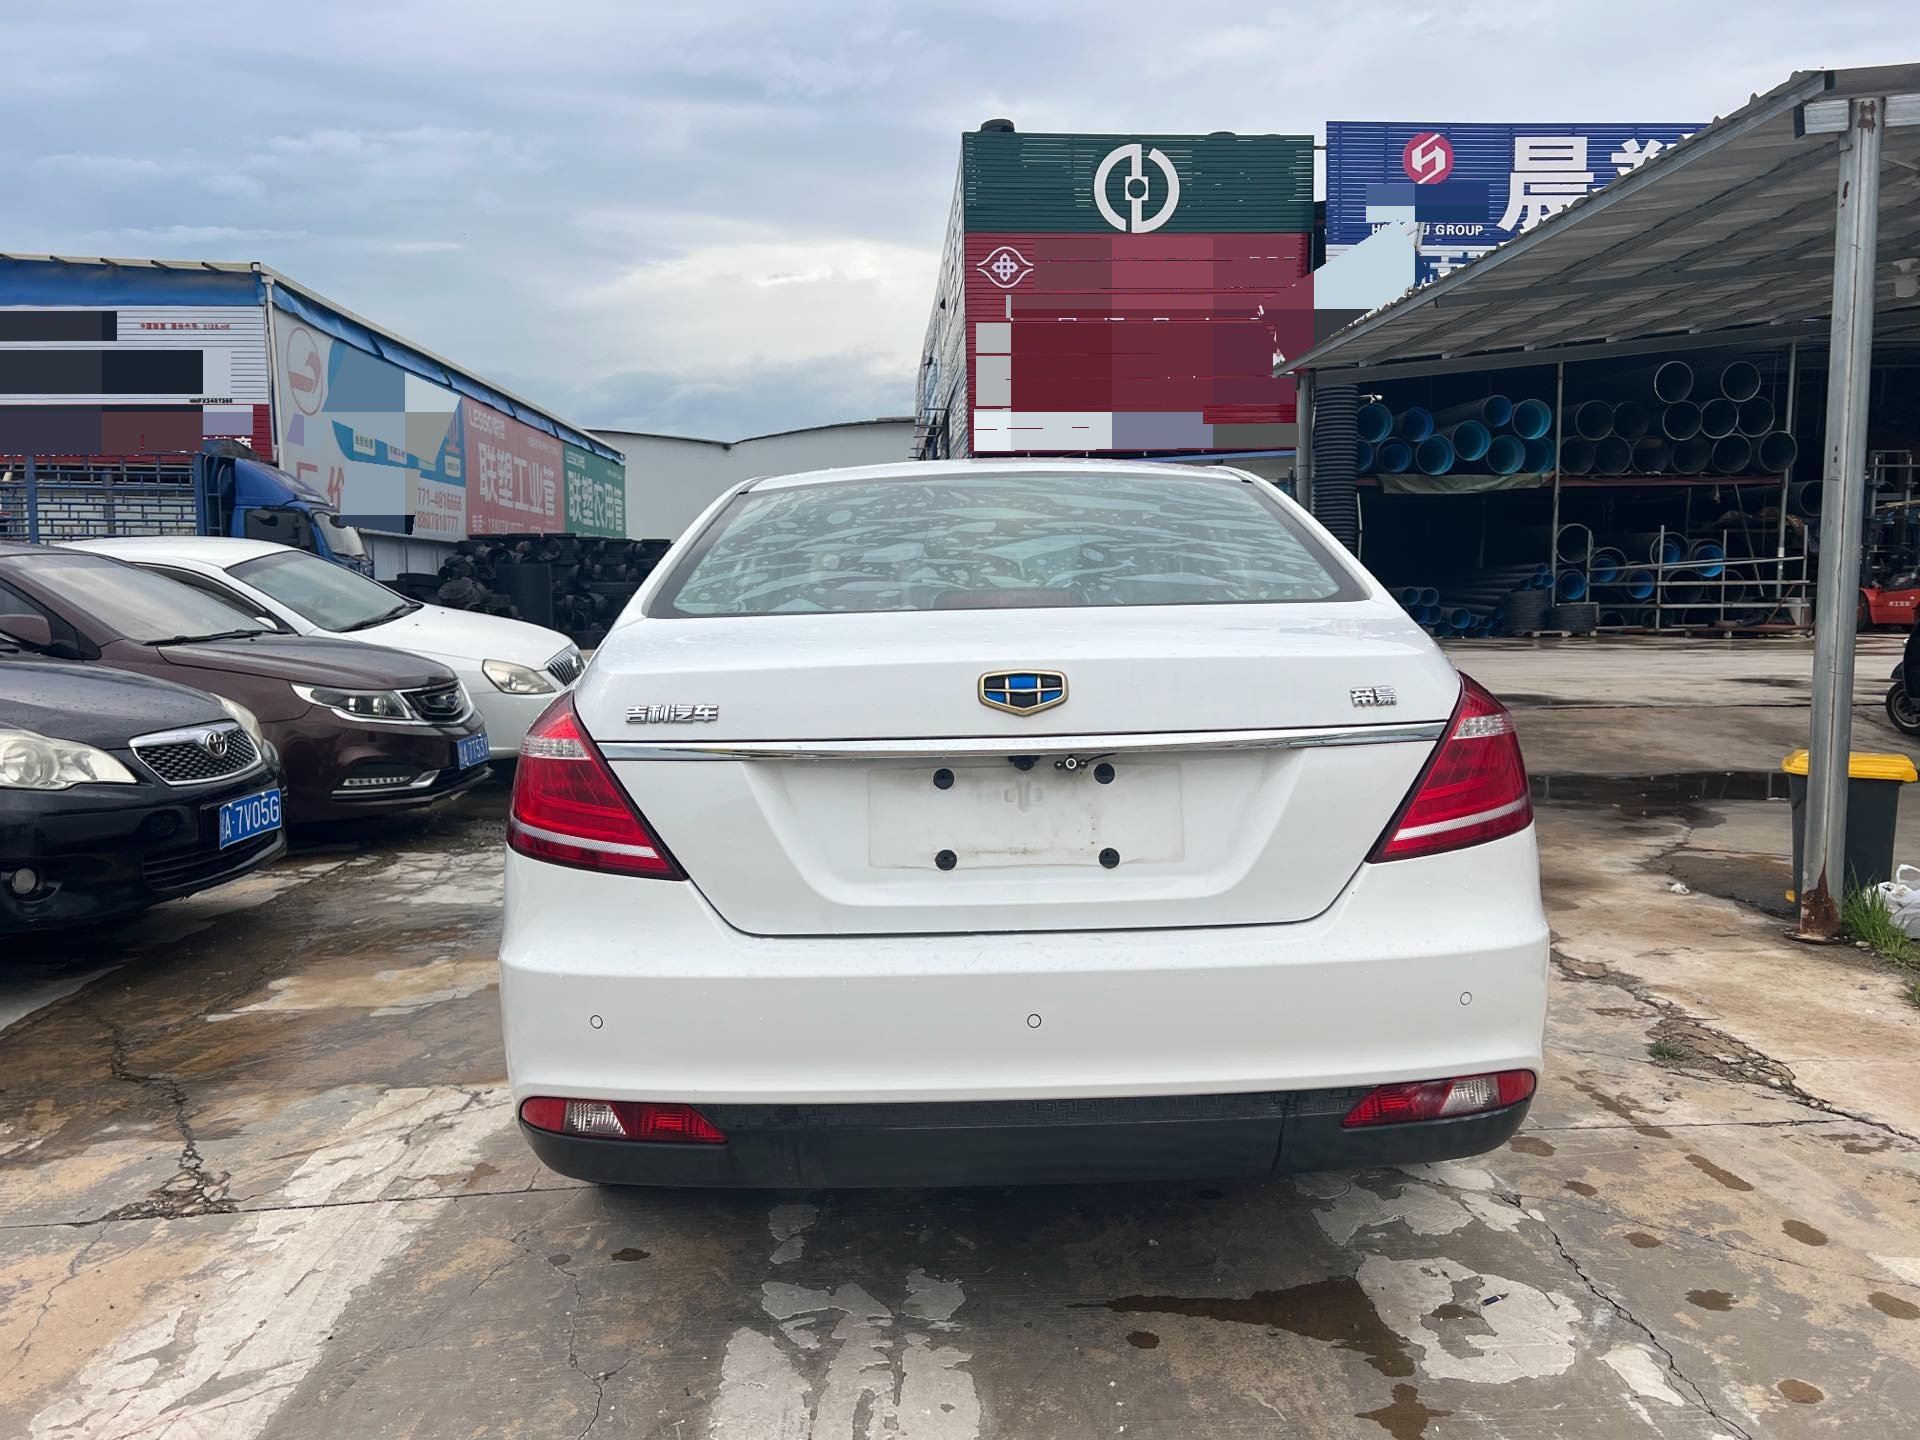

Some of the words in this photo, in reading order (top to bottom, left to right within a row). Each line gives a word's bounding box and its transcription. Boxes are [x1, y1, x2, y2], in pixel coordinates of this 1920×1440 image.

[1436, 224, 1484, 236] GROUP
[478, 442, 556, 517] 联塑工业管
[567, 470, 623, 532] 联塑农用管
[626, 704, 719, 724] 吉利汽车
